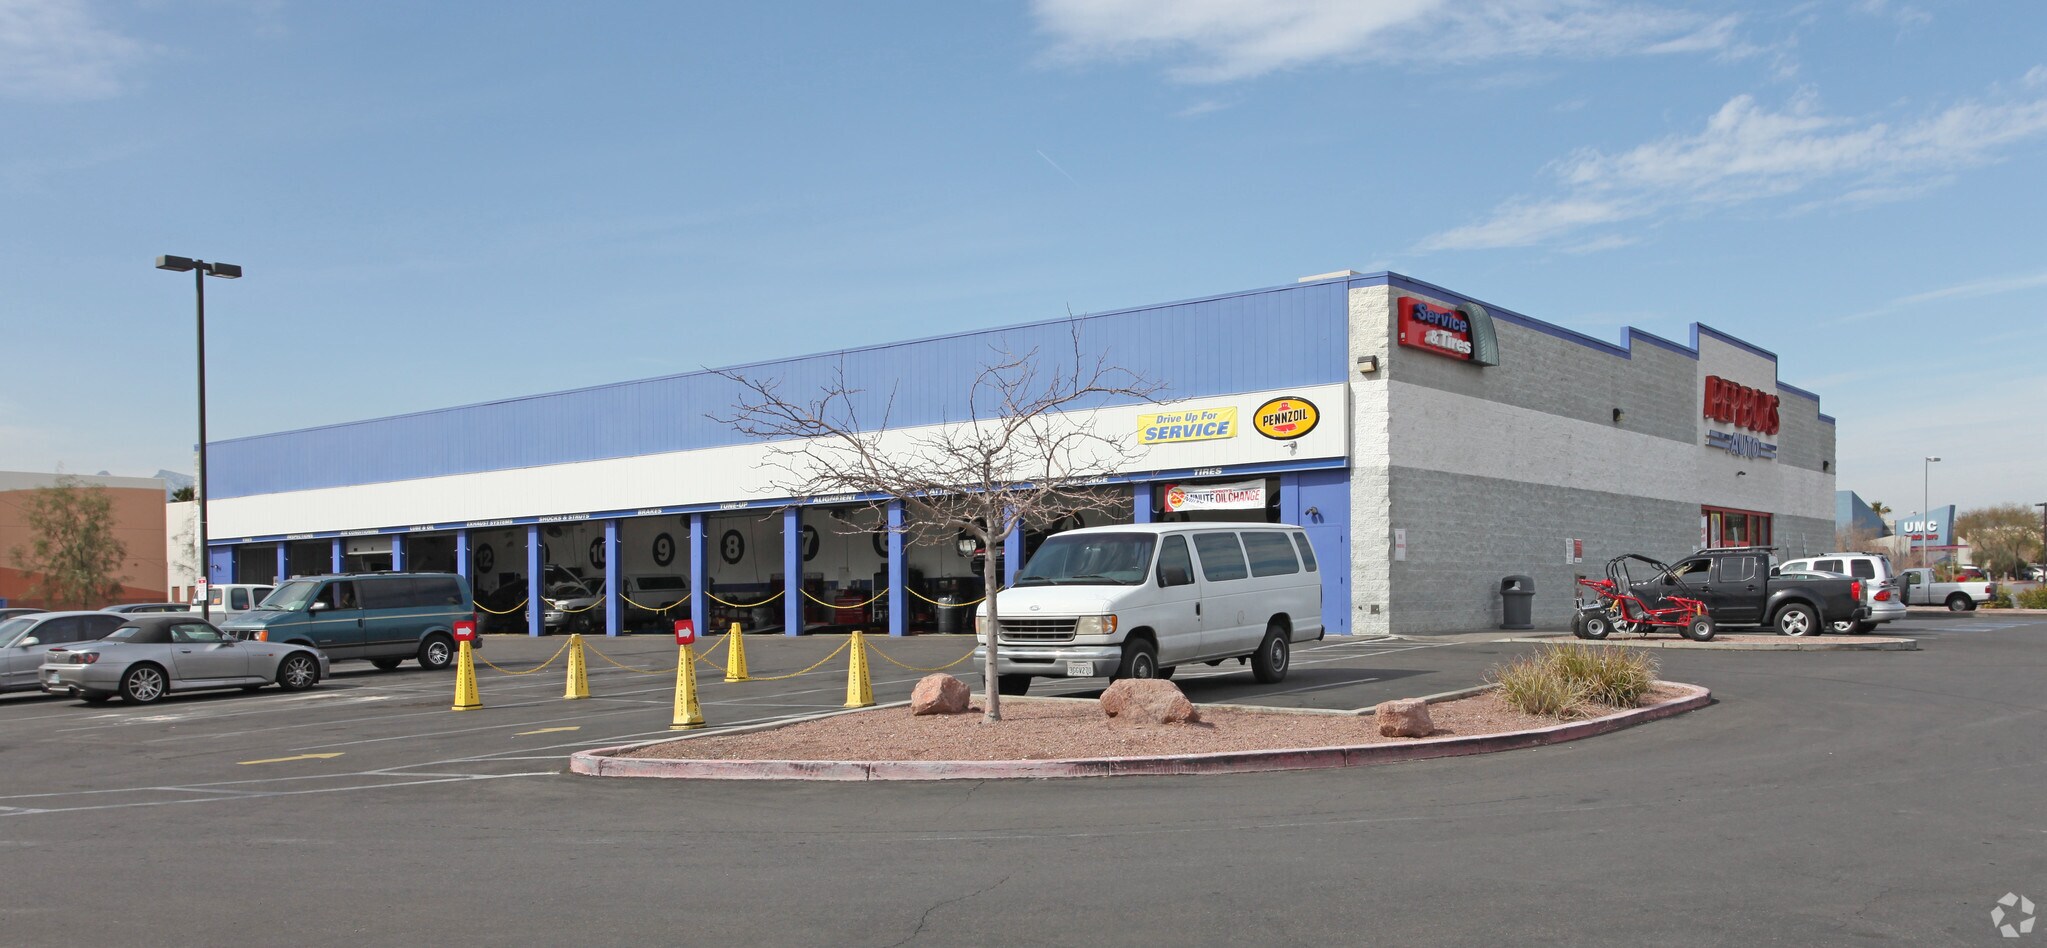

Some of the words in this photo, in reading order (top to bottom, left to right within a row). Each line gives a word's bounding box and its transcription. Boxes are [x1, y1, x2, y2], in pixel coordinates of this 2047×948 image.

[1413, 303, 1467, 332] Service
[1426, 330, 1439, 345] &
[1439, 330, 1471, 354] Tires
[1156, 414, 1182, 424] Drive
[1185, 412, 1198, 424] Up
[1201, 411, 1217, 421] For
[1262, 409, 1308, 427] PENNZOIL
[1145, 421, 1230, 441] SERVICE
[1730, 432, 1760, 458] AUTO
[1194, 467, 1222, 476] TIRES
[813, 494, 857, 503] ALIGNMENT
[1215, 492, 1227, 504] OIL
[1228, 489, 1260, 503] CHANGE
[637, 508, 662, 516] BRAKES
[720, 502, 748, 510] TUNE-UP
[1904, 520, 1938, 533] UMC
[657, 538, 670, 562] 9
[726, 534, 740, 559] 8
[478, 548, 491, 567] 12
